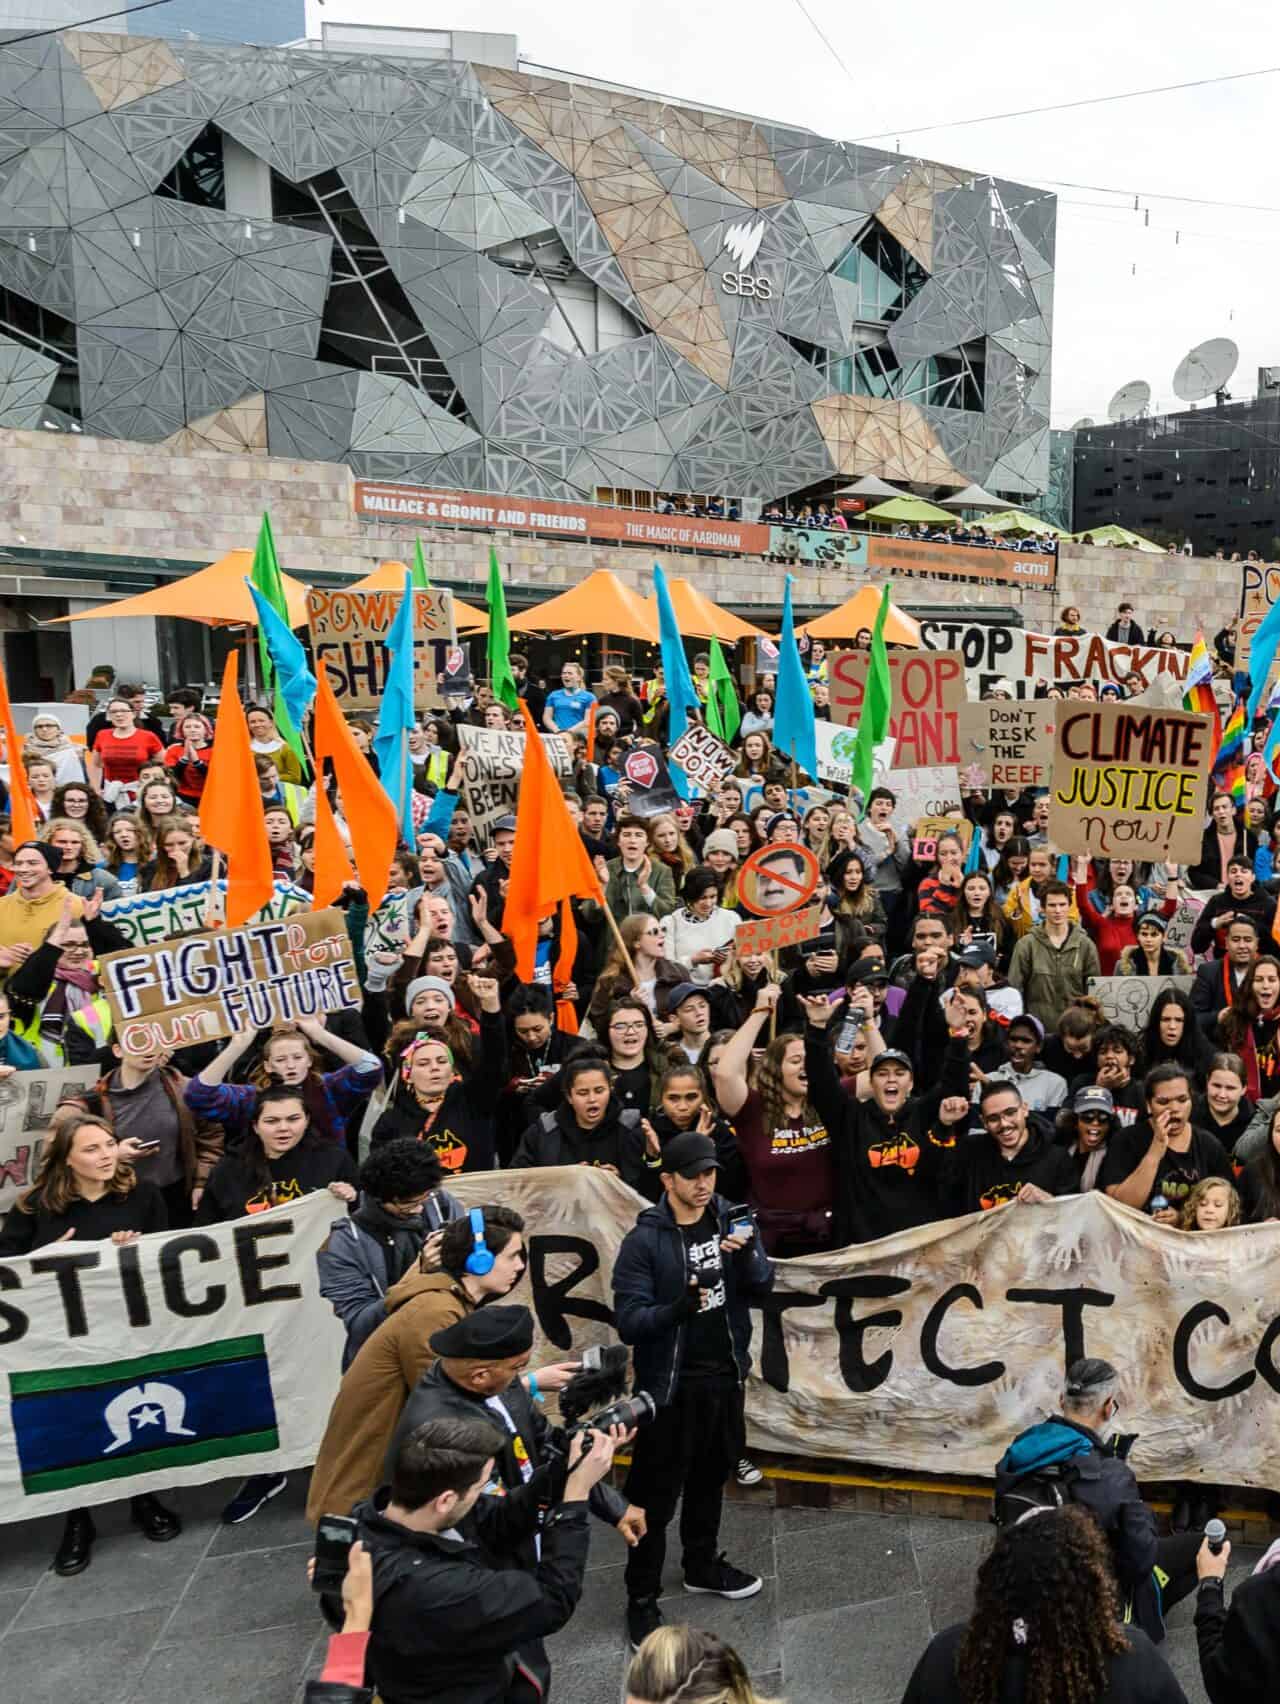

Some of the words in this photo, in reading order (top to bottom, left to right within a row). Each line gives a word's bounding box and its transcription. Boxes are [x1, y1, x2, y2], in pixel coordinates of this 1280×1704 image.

[722, 271, 772, 299] SBS
[363, 495, 424, 515] WALLACE
[427, 502, 439, 516] &
[441, 503, 495, 522] GROMIT
[497, 510, 526, 525] AND
[530, 513, 587, 532] FRIENDS
[626, 523, 645, 538] THE
[646, 526, 677, 542] MAGIC
[679, 530, 692, 542] OF
[692, 531, 741, 548] AARDMAN
[1013, 561, 1048, 576] acmi
[920, 621, 1013, 671] STOP
[989, 708, 1037, 725] DON'T
[462, 729, 489, 752] WE
[989, 727, 1037, 742] RISK
[1061, 712, 1208, 767] CLIMATE
[688, 728, 733, 773] NOW
[989, 744, 1026, 759] THE
[465, 756, 516, 782] ONES
[992, 764, 1043, 785] REEF
[469, 783, 519, 816] BEEN
[1056, 766, 1199, 815] JUSTICE
[112, 924, 285, 1017] FIGHT
[122, 1009, 209, 1056] our
[220, 959, 360, 1034] FUTURE
